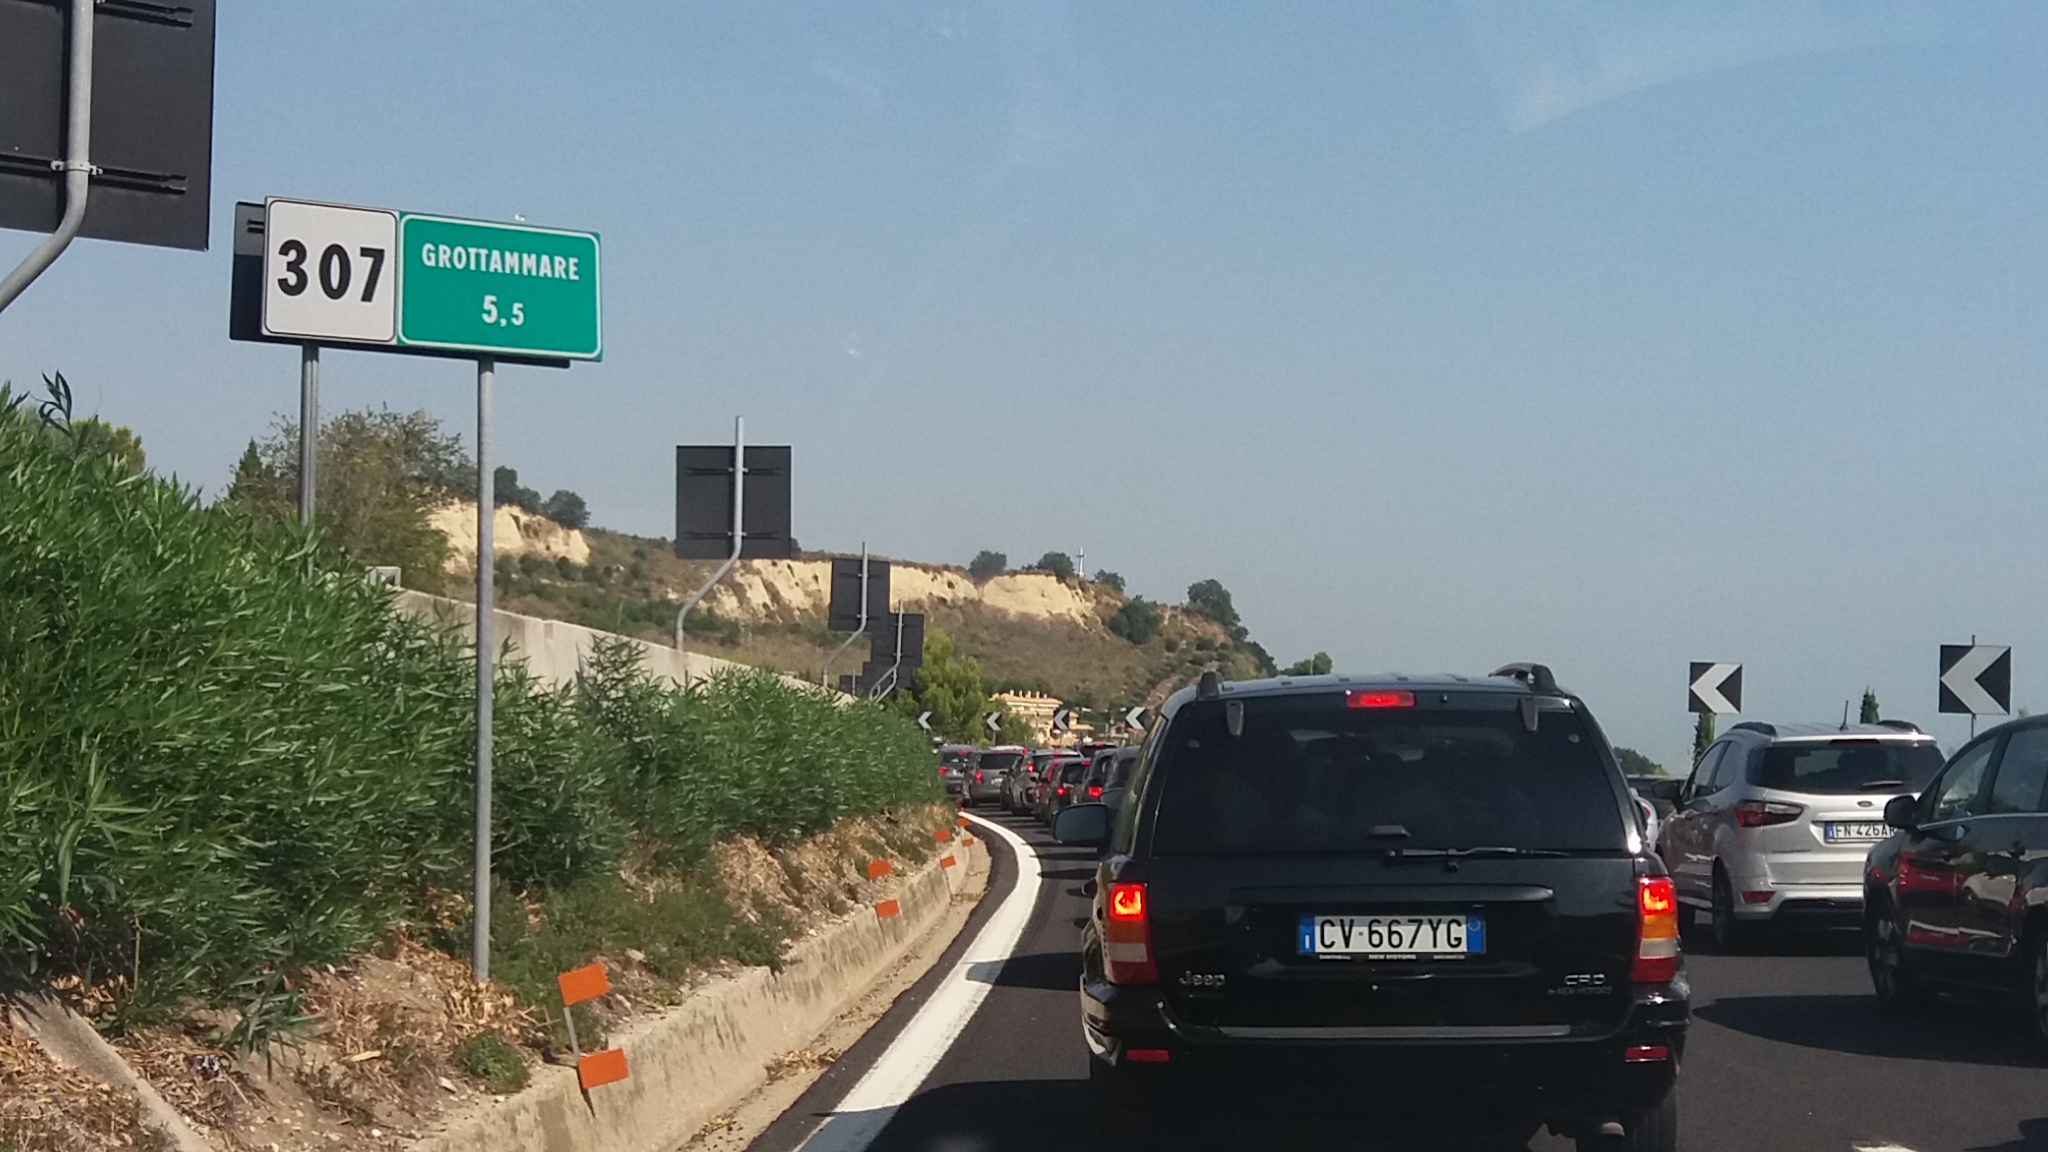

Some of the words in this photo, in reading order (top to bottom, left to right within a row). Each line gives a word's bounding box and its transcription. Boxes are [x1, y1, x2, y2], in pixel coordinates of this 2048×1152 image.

[277, 239, 385, 303] 307
[422, 242, 580, 281] GROTTAMMARE
[481, 294, 525, 327] 5,5
[1179, 970, 1226, 989] Jeep
